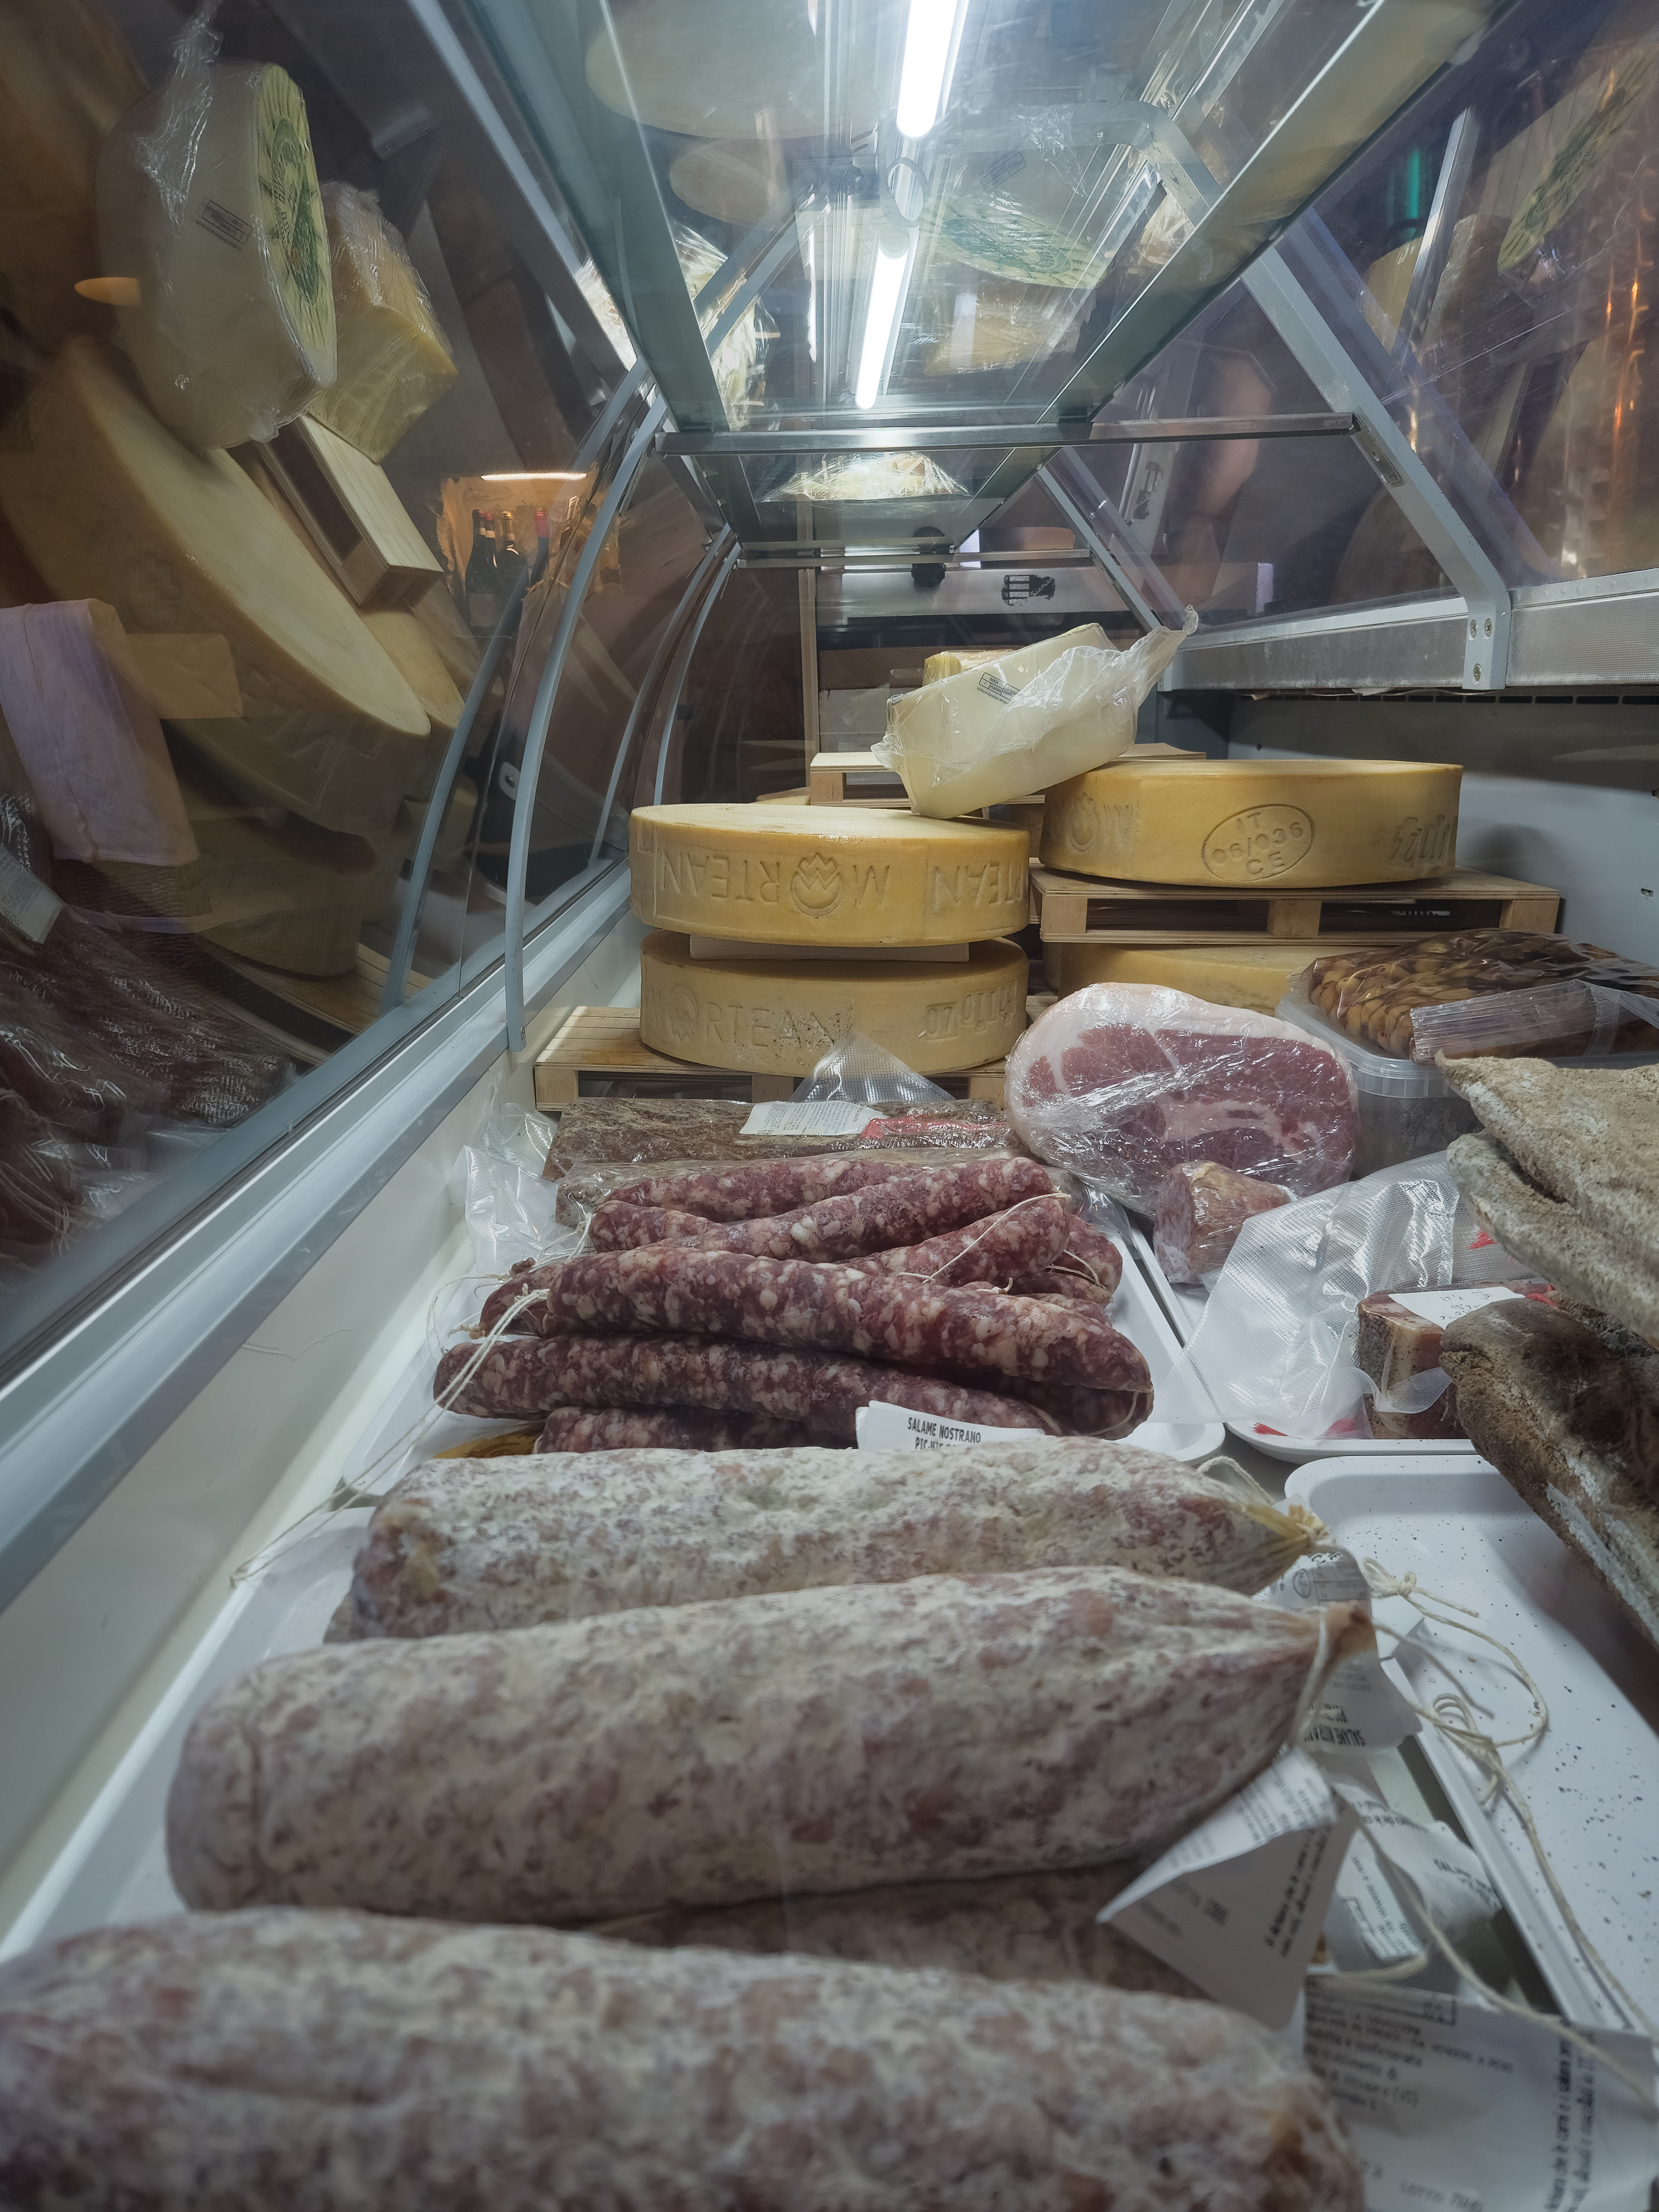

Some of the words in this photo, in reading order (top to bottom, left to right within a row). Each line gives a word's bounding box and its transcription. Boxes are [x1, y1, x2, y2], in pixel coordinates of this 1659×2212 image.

[1236, 812, 1261, 835] IT
[1245, 850, 1285, 875] CE
[907, 1417, 937, 1437] SALAME
[939, 1425, 981, 1443] NOSTRANO
